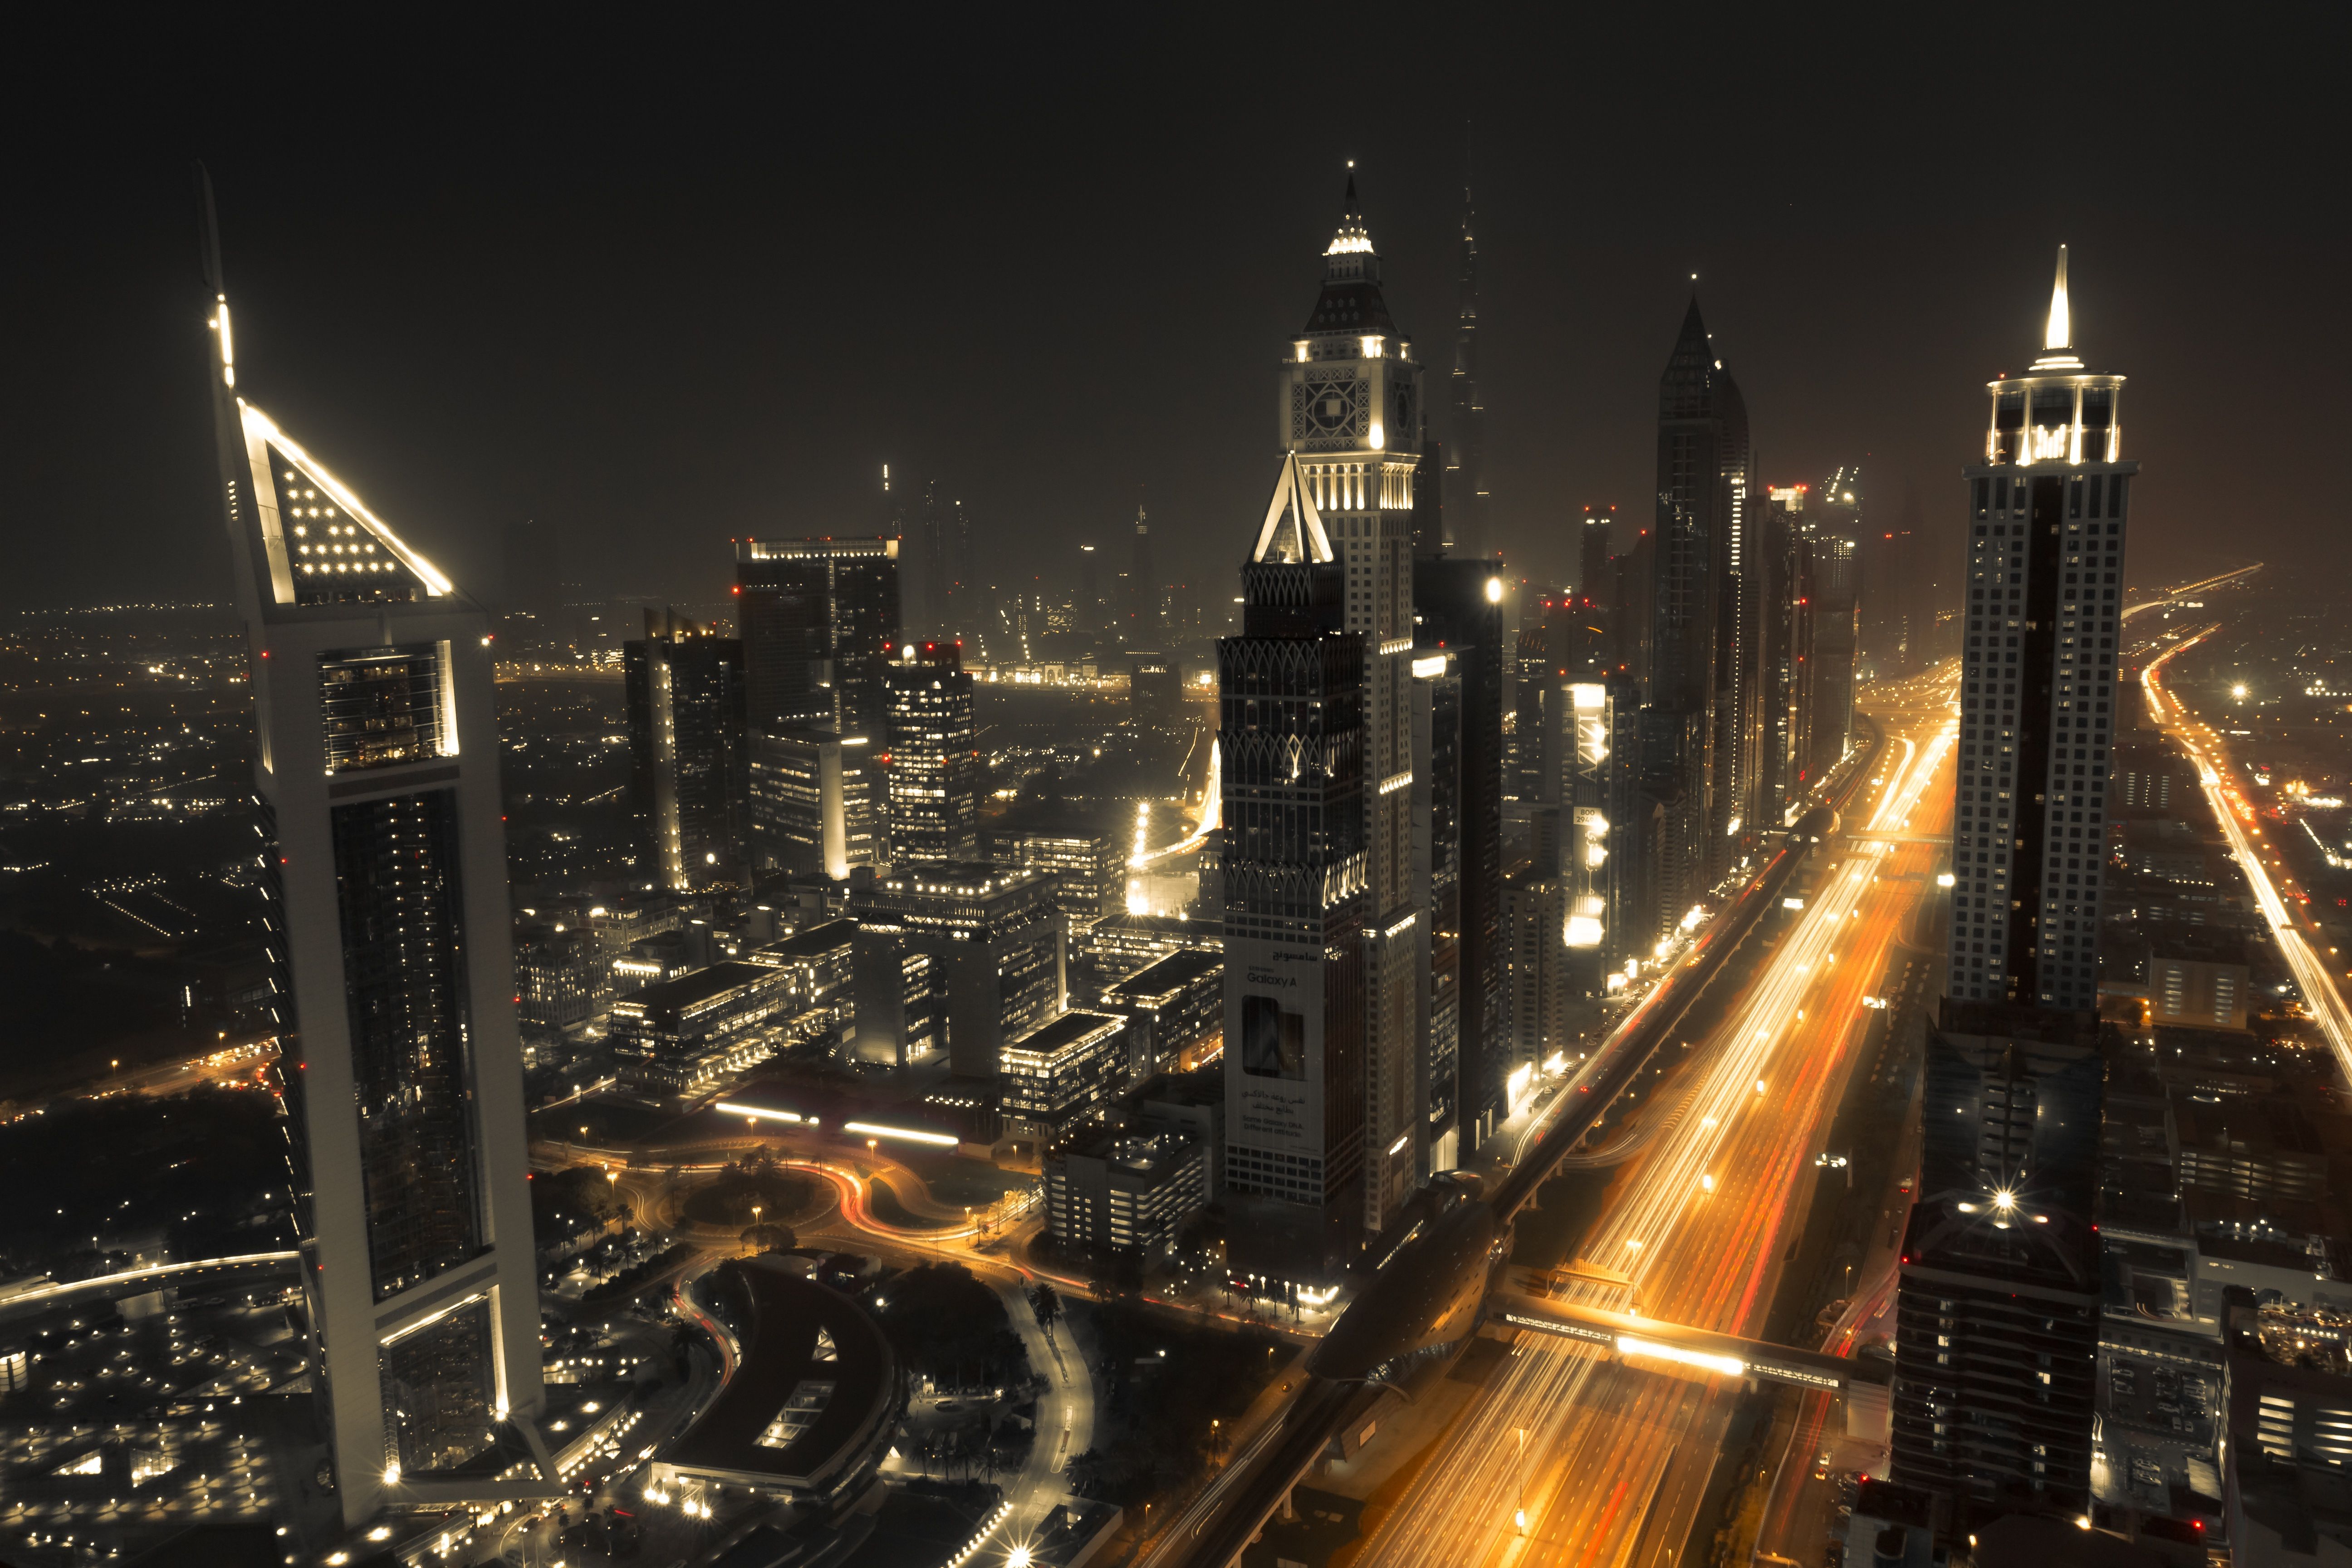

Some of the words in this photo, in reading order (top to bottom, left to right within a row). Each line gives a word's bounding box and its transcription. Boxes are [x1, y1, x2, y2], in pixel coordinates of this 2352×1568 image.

[1578, 714, 1598, 784] AZIZI
[1273, 951, 1318, 961] سامسونج
[1247, 972, 1288, 989] Galaxy
[1290, 977, 1297, 987] A
[1243, 1114, 1261, 1123] Same
[1263, 1118, 1287, 1128] Galaxy
[1244, 1122, 1273, 1133] Different
